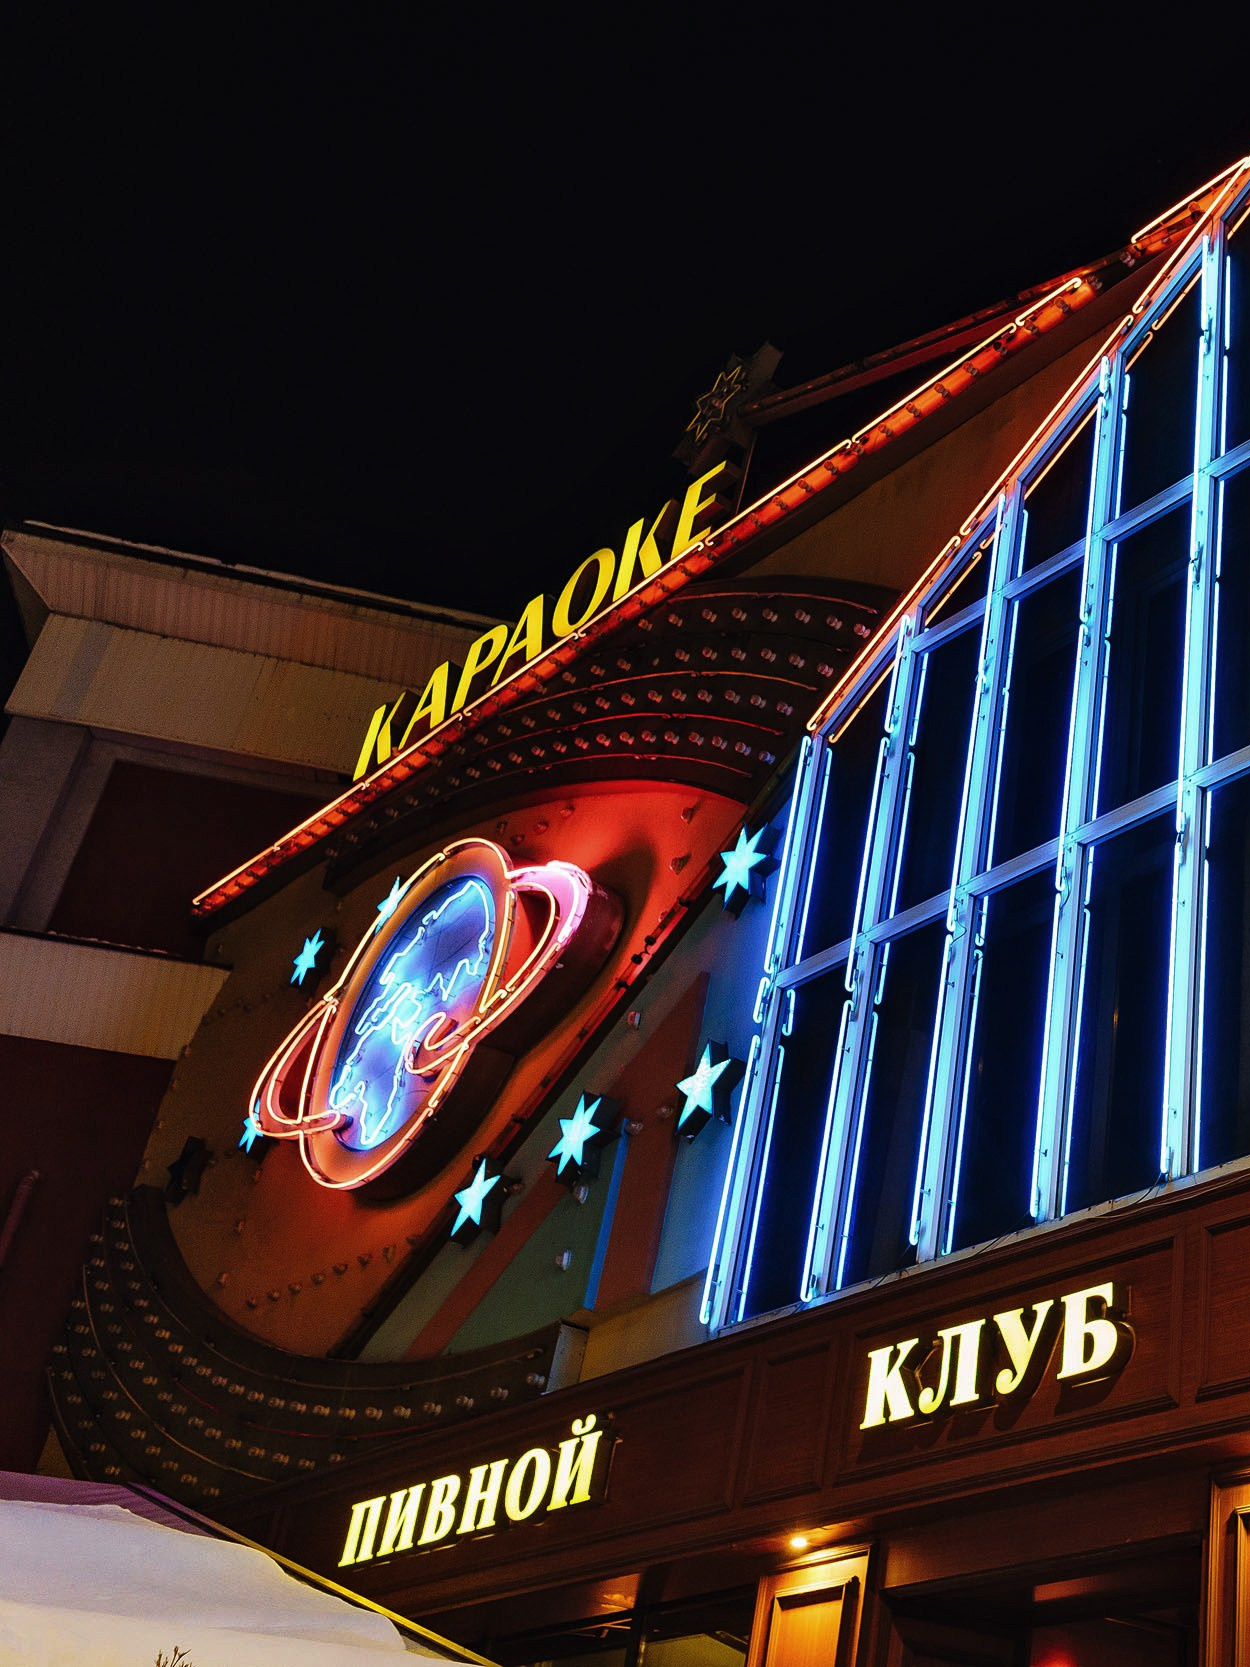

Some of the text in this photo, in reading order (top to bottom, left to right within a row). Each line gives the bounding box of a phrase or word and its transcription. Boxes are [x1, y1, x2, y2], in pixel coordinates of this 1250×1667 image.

[353, 460, 727, 781] КАРАОКЕ
[338, 1282, 1118, 1567] ПИВНОЙ КЛУБ
